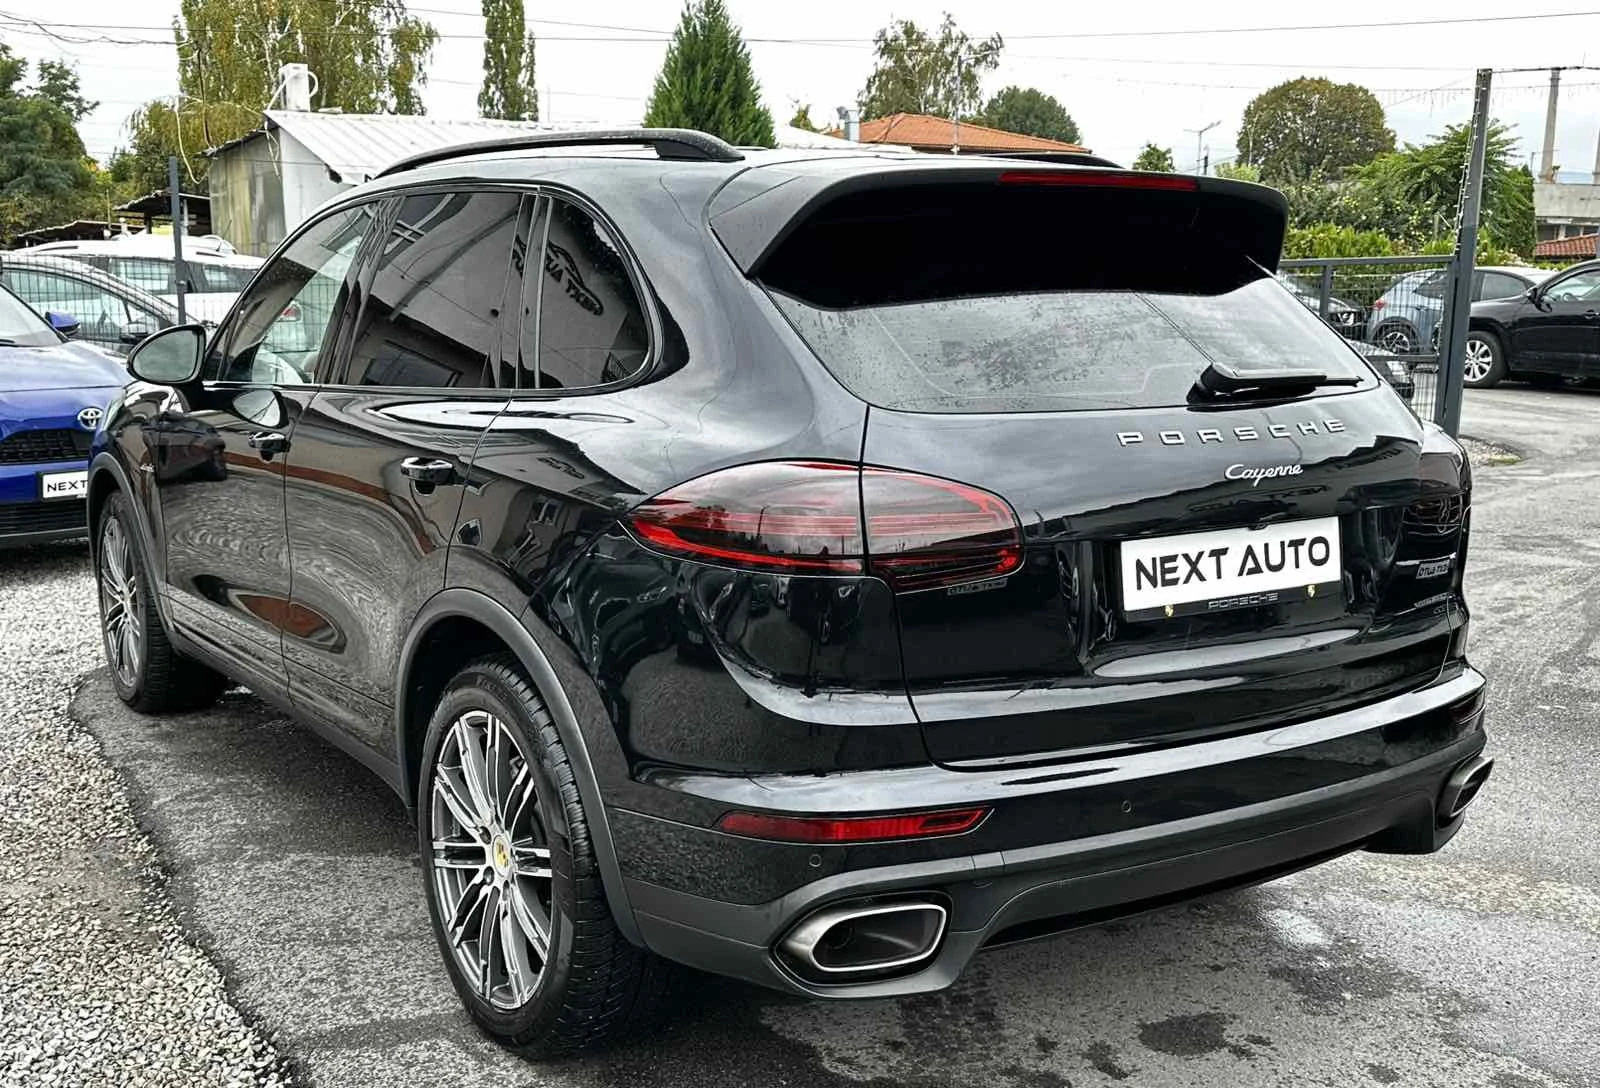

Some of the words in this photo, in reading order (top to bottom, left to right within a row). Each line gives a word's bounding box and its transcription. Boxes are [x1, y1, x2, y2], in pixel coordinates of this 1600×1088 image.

[1117, 418, 1346, 446] PORSCHE
[47, 480, 88, 492] NEXT
[1225, 463, 1303, 487] Cayenne
[1135, 547, 1230, 590] NEXT
[1237, 536, 1330, 577] AUTO
[1208, 592, 1279, 610] PORSCHE
